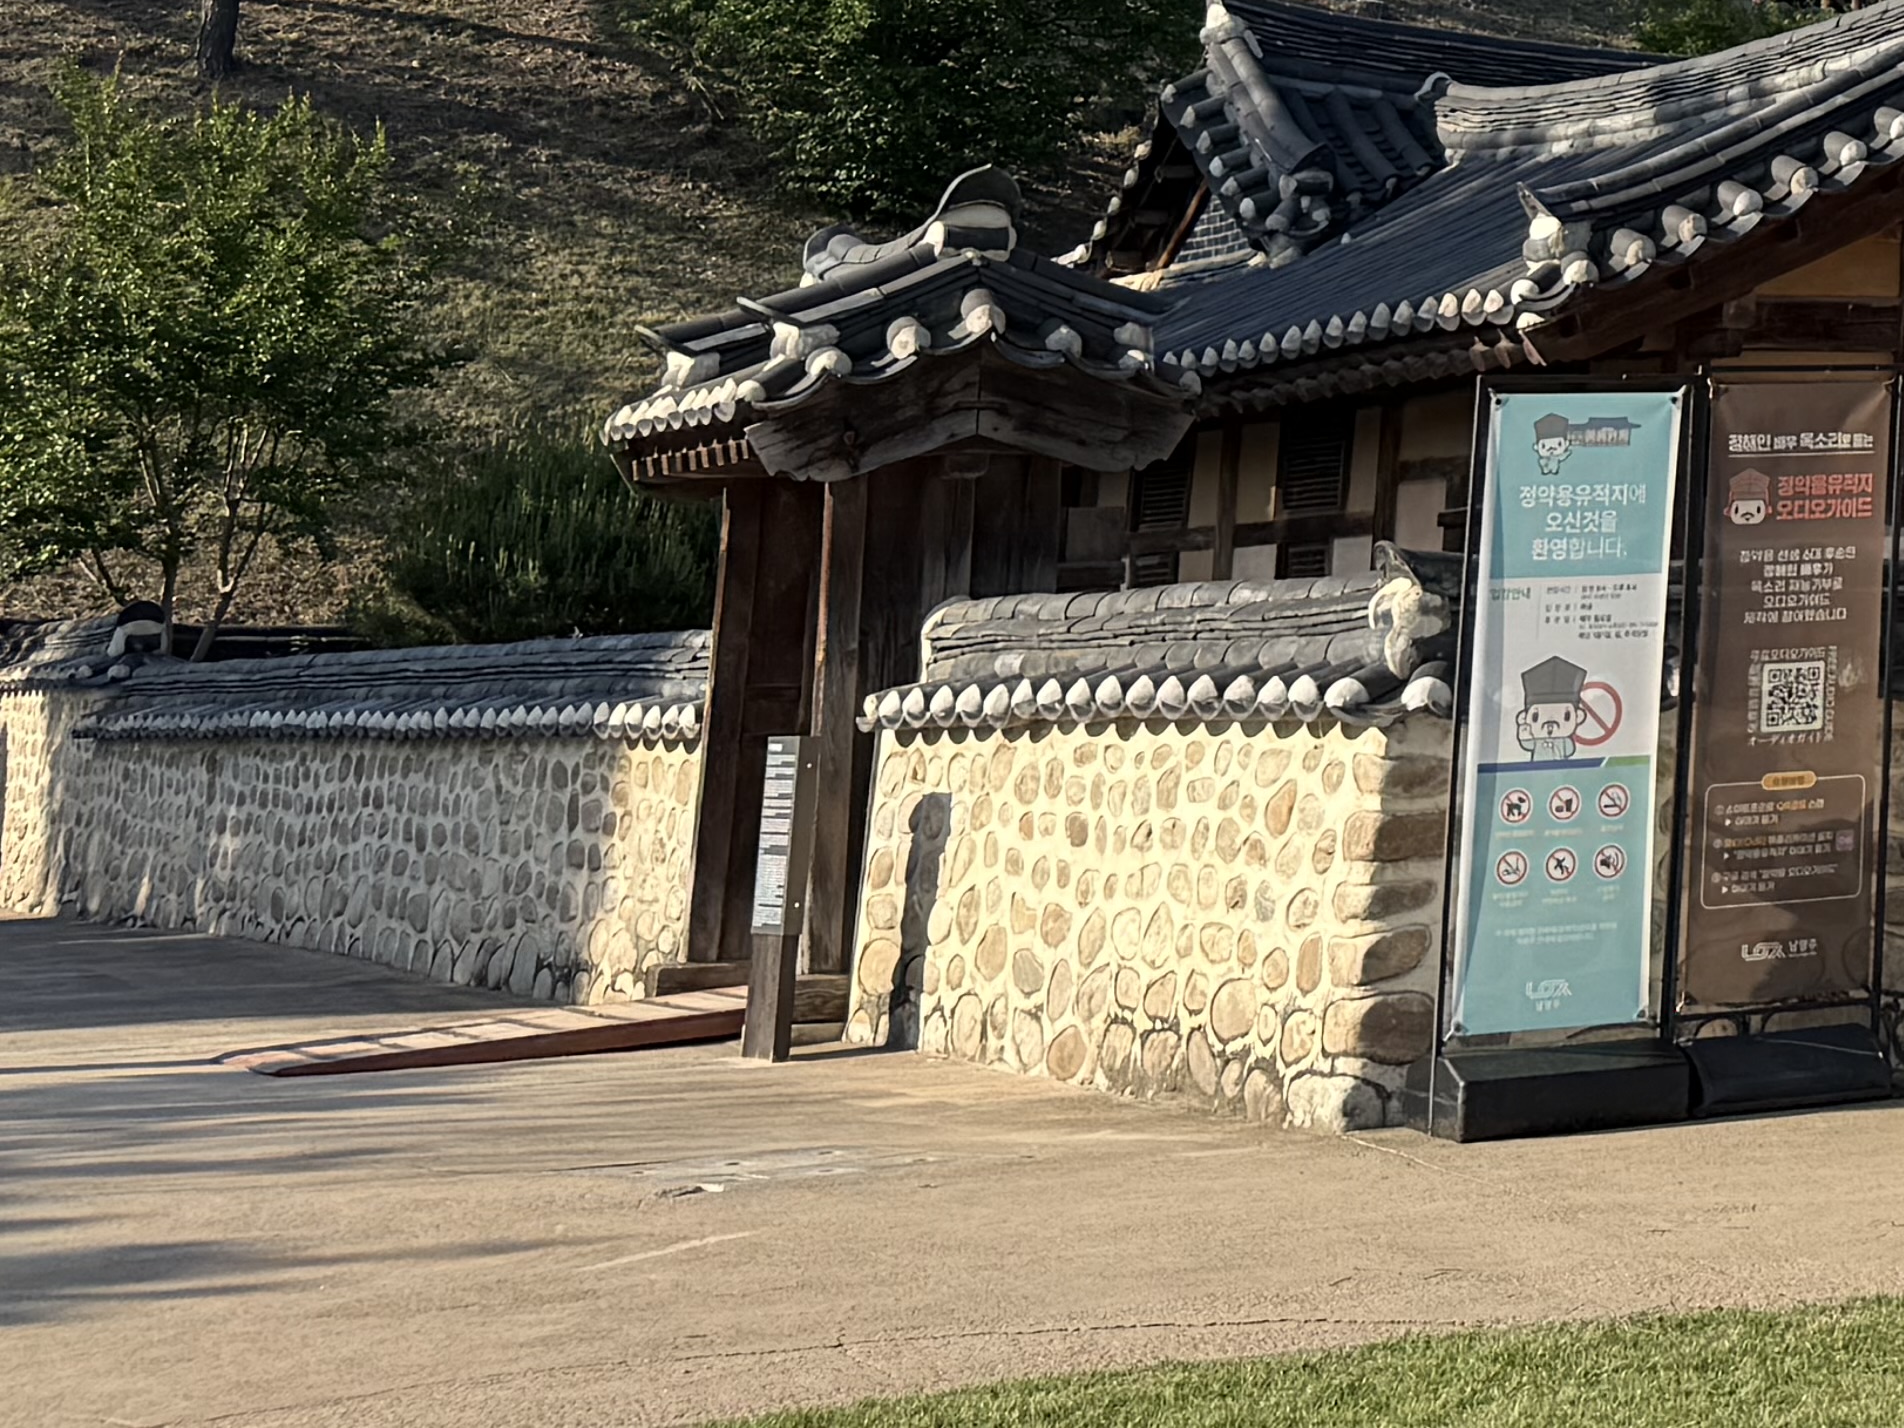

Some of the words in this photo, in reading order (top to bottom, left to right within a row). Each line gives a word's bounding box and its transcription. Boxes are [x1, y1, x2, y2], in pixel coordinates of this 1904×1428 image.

[1728, 434, 1771, 452] 정해인
[1519, 483, 1646, 508] 정약용유적지에
[1776, 497, 1873, 520] 오디오가이드
[1545, 510, 1617, 533] 오신것을
[1532, 535, 1628, 560] 환영합니다.
